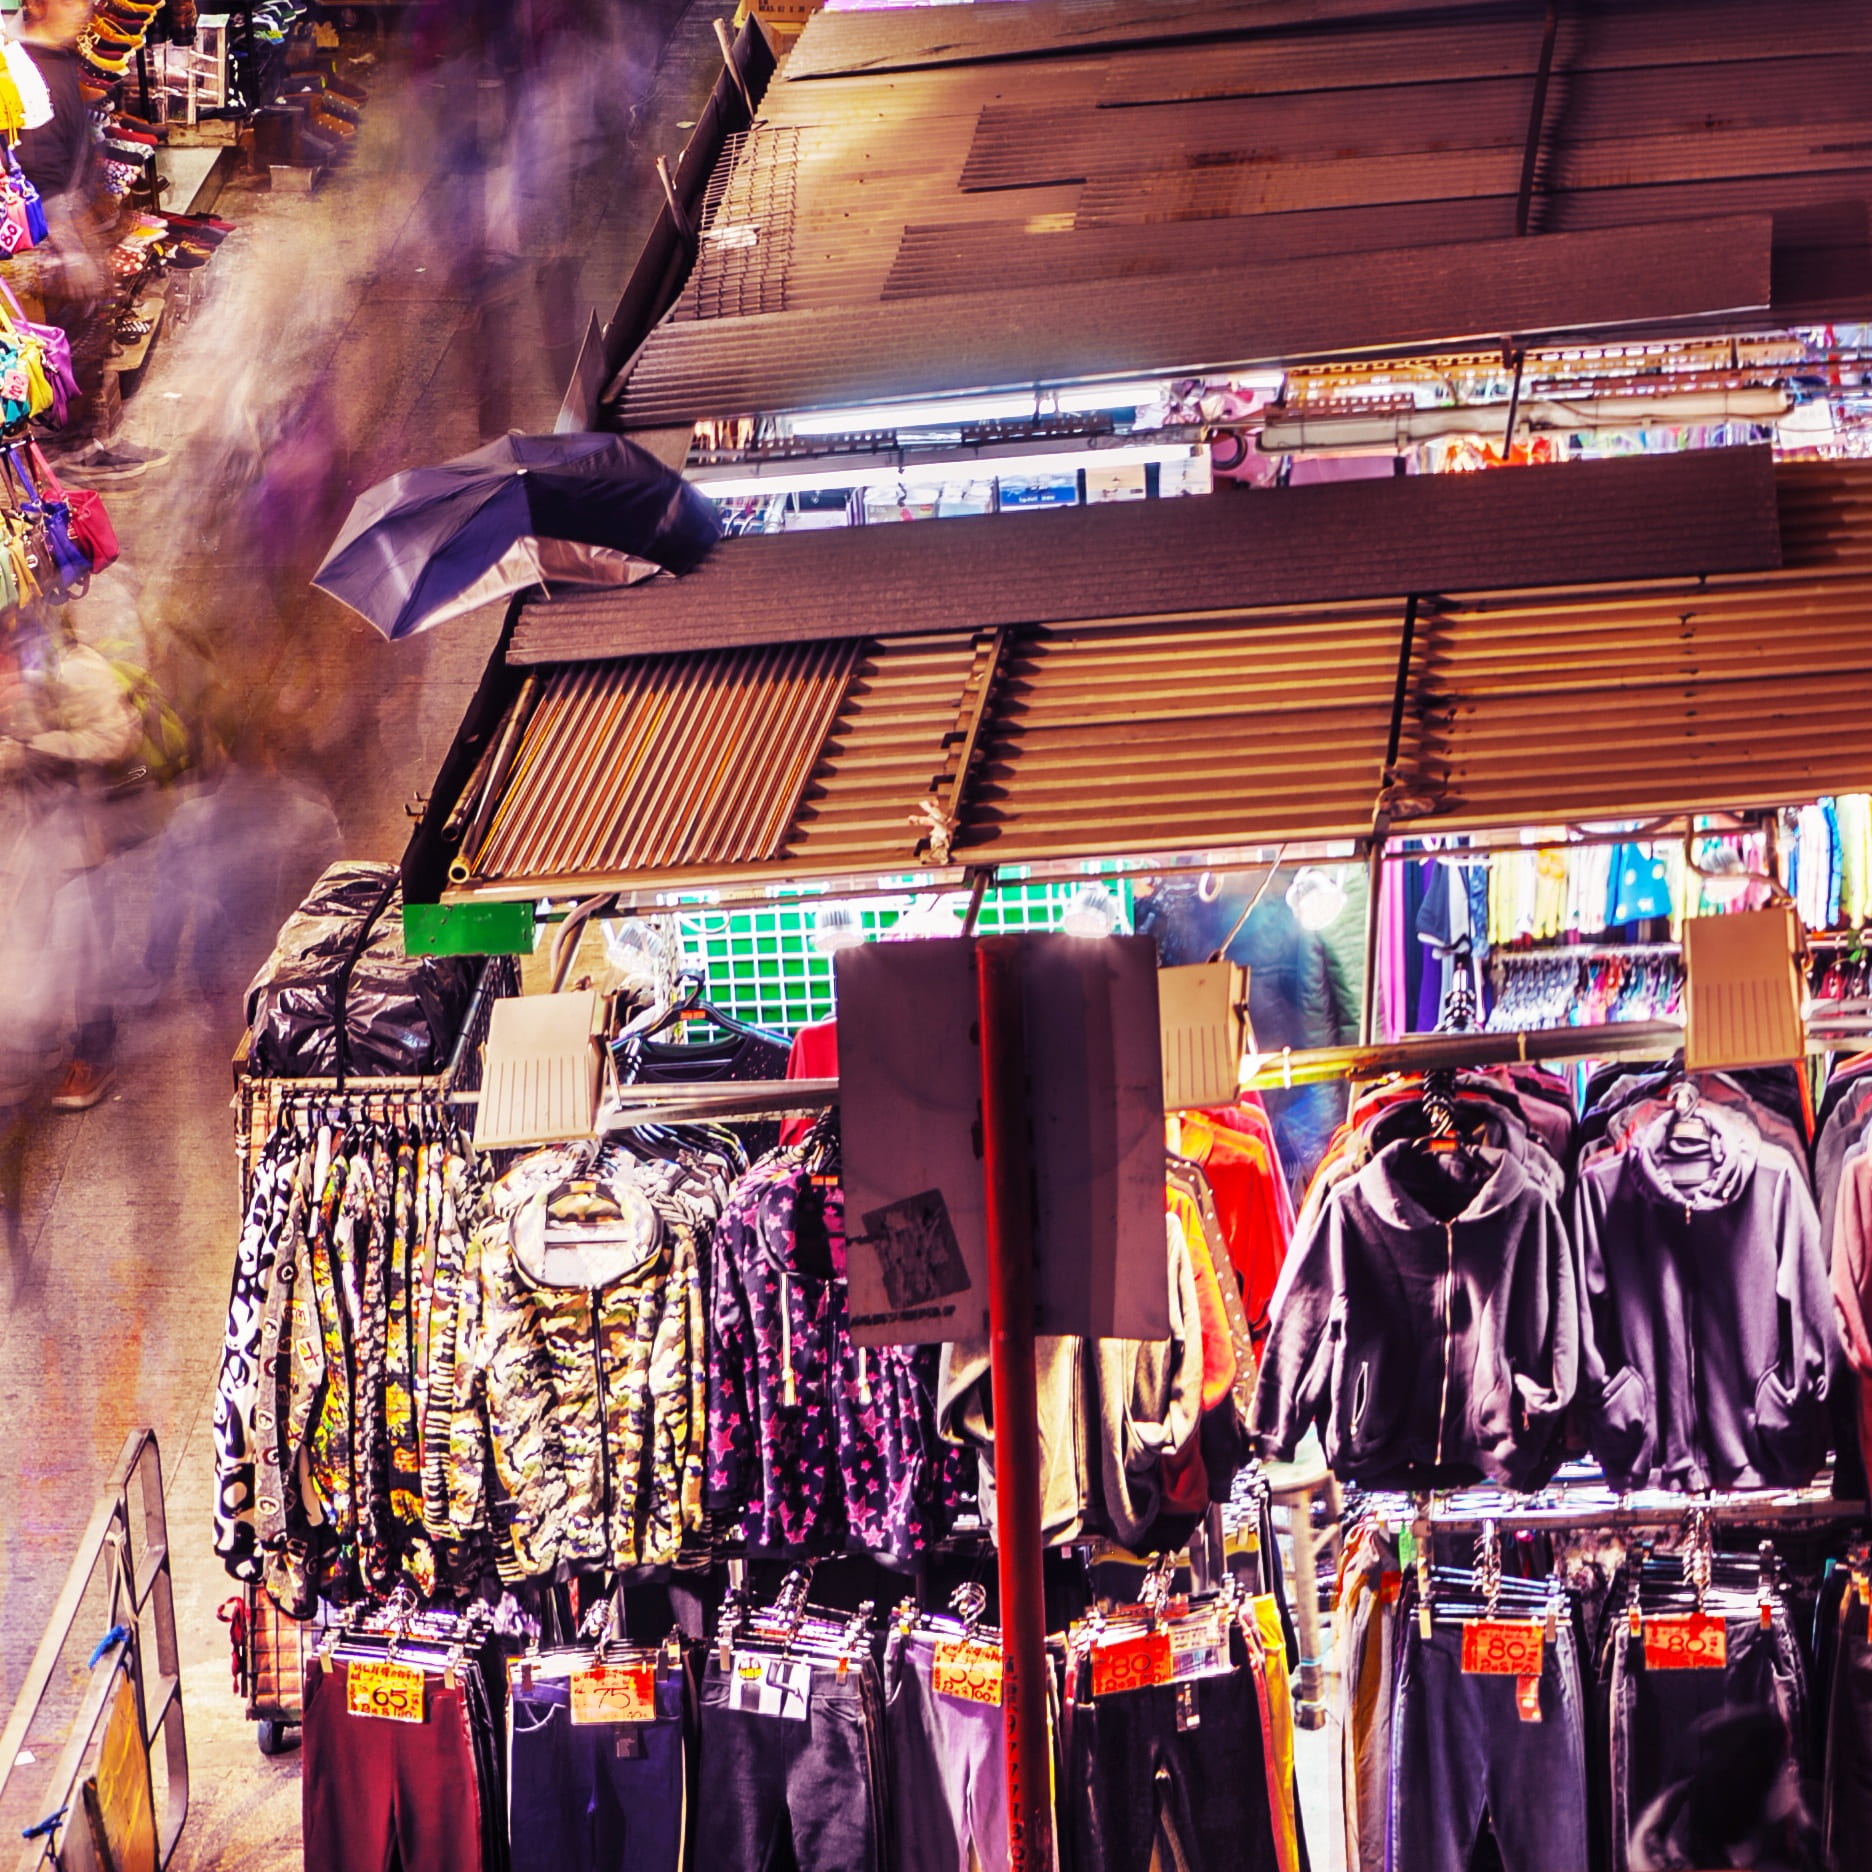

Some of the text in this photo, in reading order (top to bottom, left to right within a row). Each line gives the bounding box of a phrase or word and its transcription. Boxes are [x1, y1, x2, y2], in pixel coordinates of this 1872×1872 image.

[1488, 1636, 1526, 1660] 80
[1668, 1635, 1706, 1654] 80
[1112, 1653, 1150, 1678] 80
[373, 1686, 408, 1708] 65
[594, 1686, 631, 1710] 75
